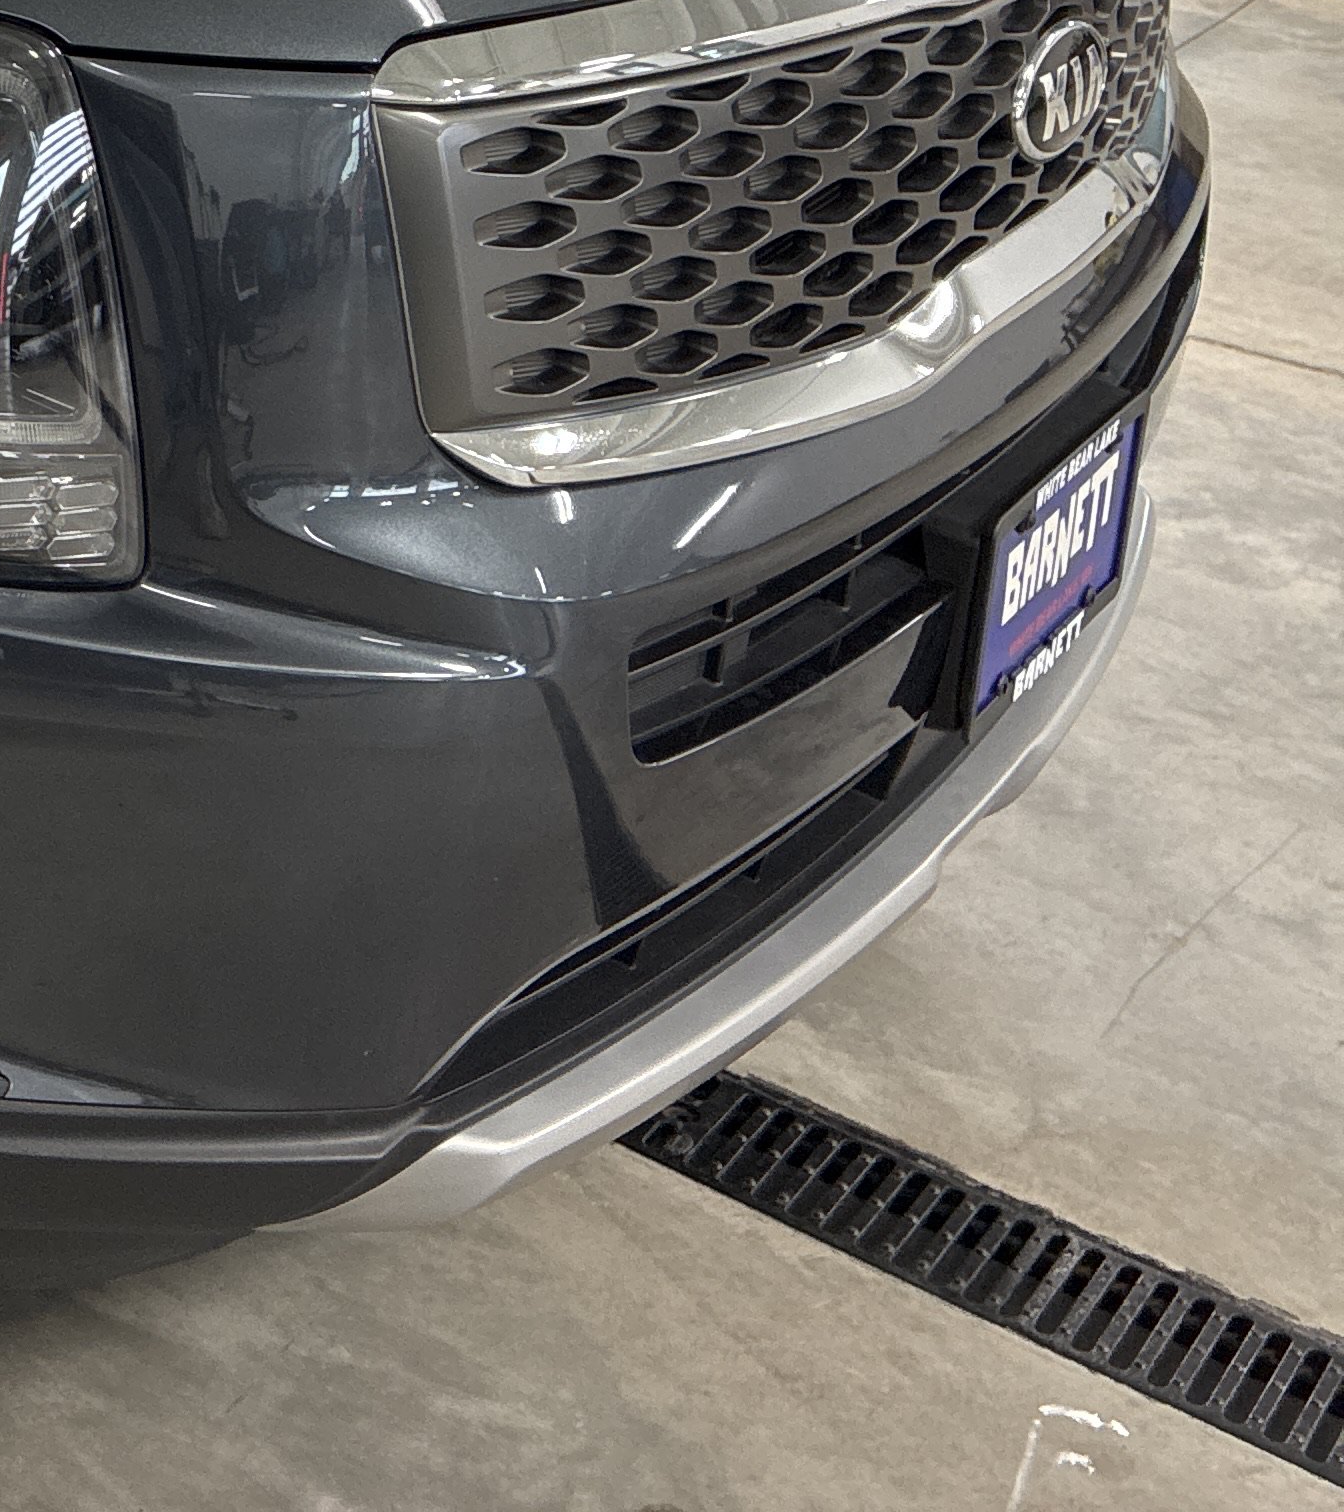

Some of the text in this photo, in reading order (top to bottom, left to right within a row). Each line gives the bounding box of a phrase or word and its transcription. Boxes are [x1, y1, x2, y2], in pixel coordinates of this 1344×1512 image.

[1039, 44, 1104, 143] KIA
[1036, 418, 1120, 512] WHITE BEAR LAKE
[1001, 450, 1120, 626] BARNETT
[1013, 609, 1085, 702] BARNETT
